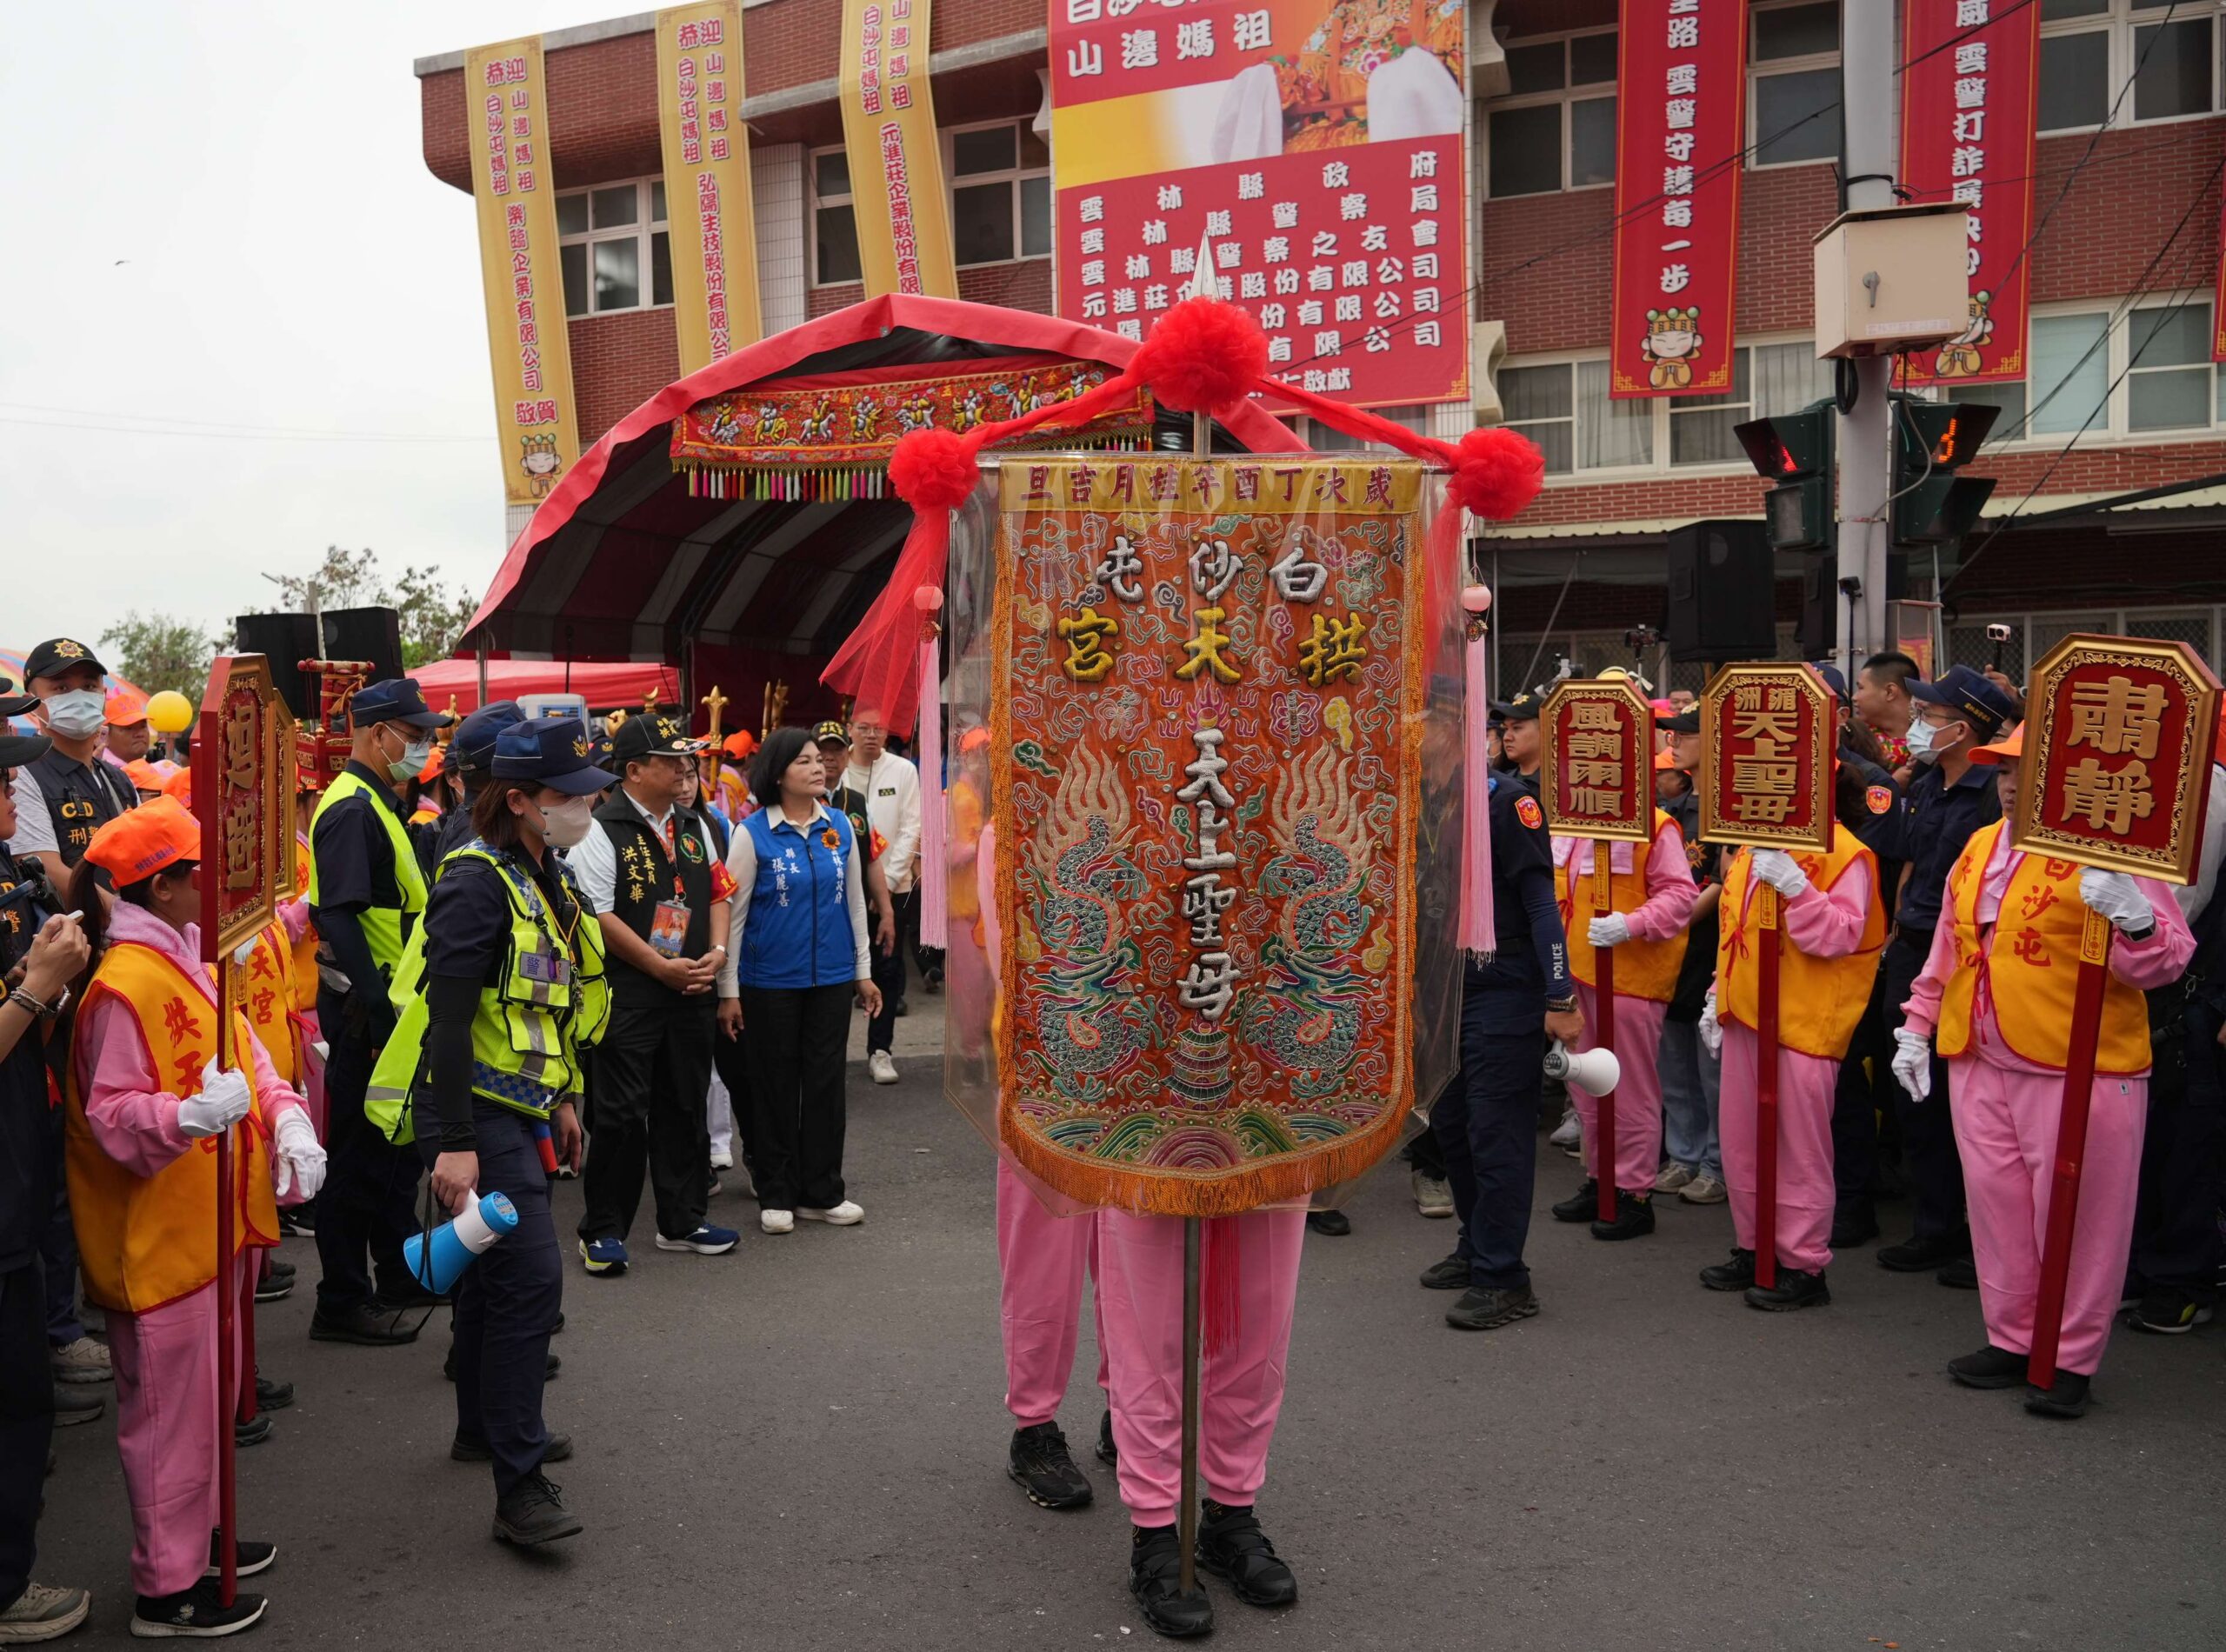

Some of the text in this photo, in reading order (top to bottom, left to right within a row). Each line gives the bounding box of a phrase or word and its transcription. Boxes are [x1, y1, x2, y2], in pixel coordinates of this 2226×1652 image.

[678, 19, 721, 49] 恭迎
[861, 5, 883, 113] 白沙屯媽祖
[1067, 10, 1272, 77] 山邊媽祖
[487, 57, 526, 85] 恭迎
[705, 53, 729, 160] 山邊媽祖
[486, 95, 510, 195] 白沙屯媽祖
[510, 90, 536, 191] 山邊媽祖
[678, 58, 702, 163] 白沙屯媽祖
[1079, 150, 1439, 223] 雲林縣政府
[1660, 64, 1697, 294] 雲警守護每一步
[1080, 185, 1439, 255] 雲林縣警察局
[1081, 219, 1439, 287] 雲林縣警察之友會
[515, 401, 556, 424] 敬賀
[1096, 536, 1329, 603] 白沙屯
[1056, 607, 1368, 687] 拱天宮
[1568, 701, 1623, 818] 風調雨順
[1731, 711, 1798, 823] 天上聖母
[2061, 676, 2169, 835] 肅靜
[62, 801, 94, 817] CD
[622, 845, 645, 903] 洪文華
[636, 834, 656, 885] 主任委員
[1176, 728, 1238, 1022] 天上聖母
[1551, 943, 1563, 980] POLICE
